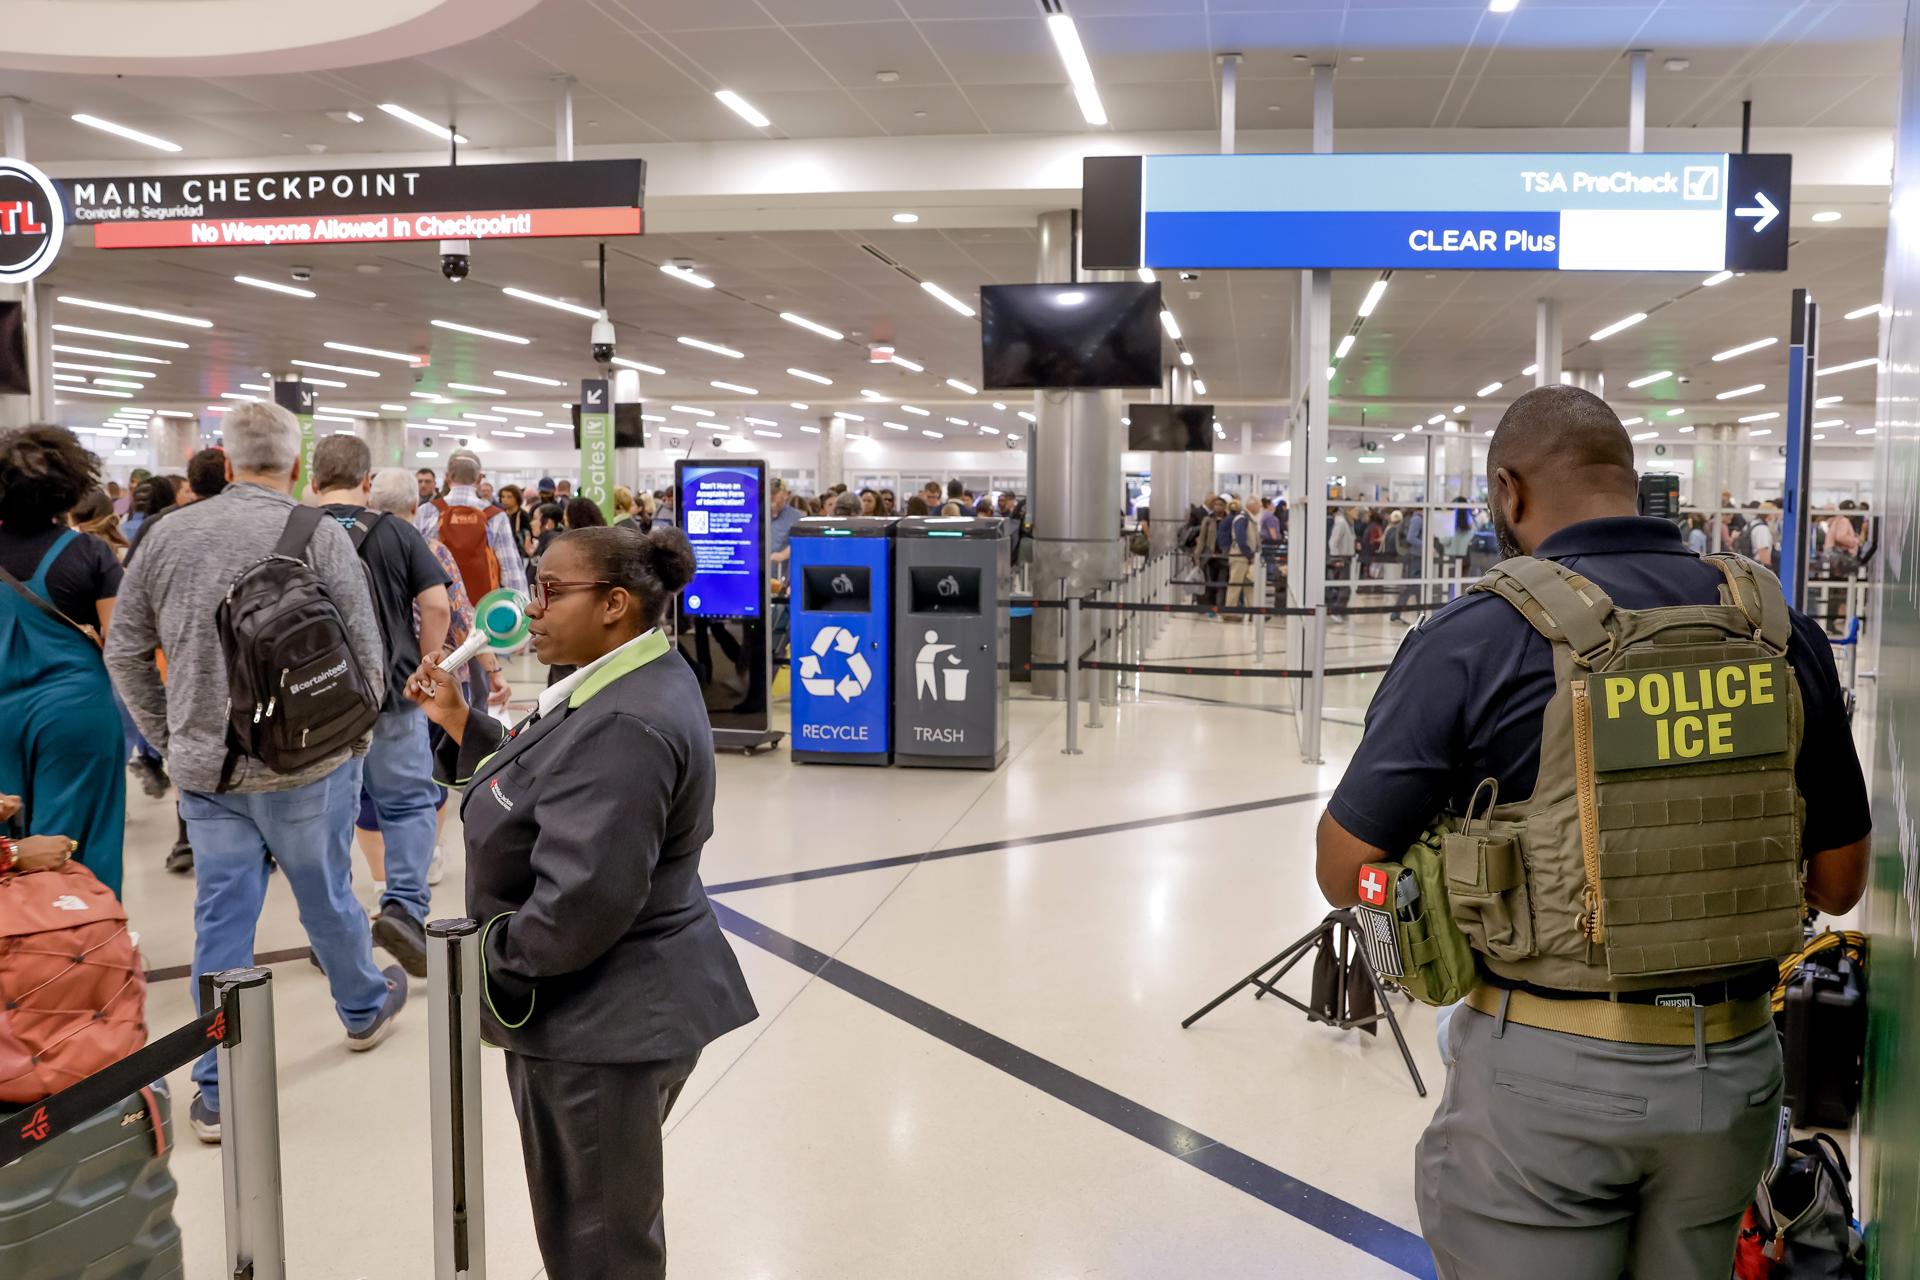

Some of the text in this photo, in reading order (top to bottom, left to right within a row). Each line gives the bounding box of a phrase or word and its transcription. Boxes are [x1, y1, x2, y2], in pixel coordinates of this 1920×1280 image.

[73, 172, 421, 206] MAIN CHECKPOINT
[1521, 171, 1680, 194] TSA PreCheck
[0, 200, 47, 235] TL
[75, 203, 204, 221] Control de Seguridad
[191, 213, 531, 244] No Weapons Allowed in Checkpoint!
[1408, 229, 1556, 253] CLEAR Plus
[1604, 663, 1774, 719] POLICE
[802, 724, 869, 740] RECYCLE
[913, 726, 964, 743] TRASH
[1656, 712, 1734, 761] ICE
